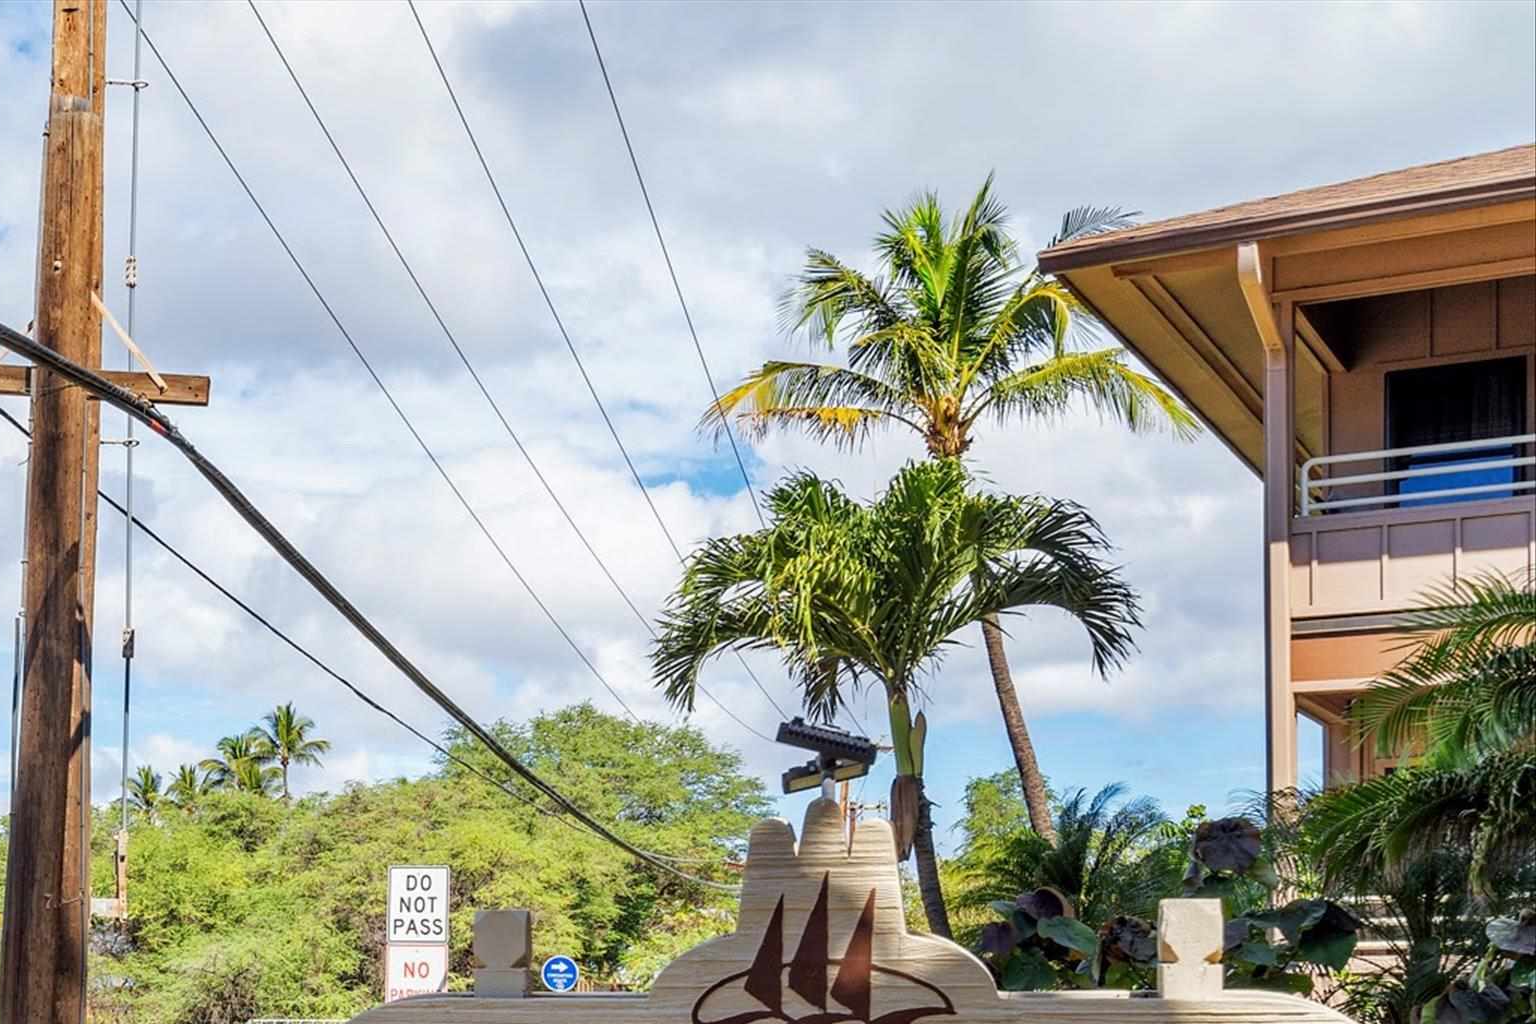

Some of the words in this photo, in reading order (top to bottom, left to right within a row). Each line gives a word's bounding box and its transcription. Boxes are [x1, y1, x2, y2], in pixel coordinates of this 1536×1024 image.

[405, 874, 433, 892] DO
[399, 896, 438, 913] NOT
[393, 918, 443, 936] PASS
[403, 961, 430, 979] NO
